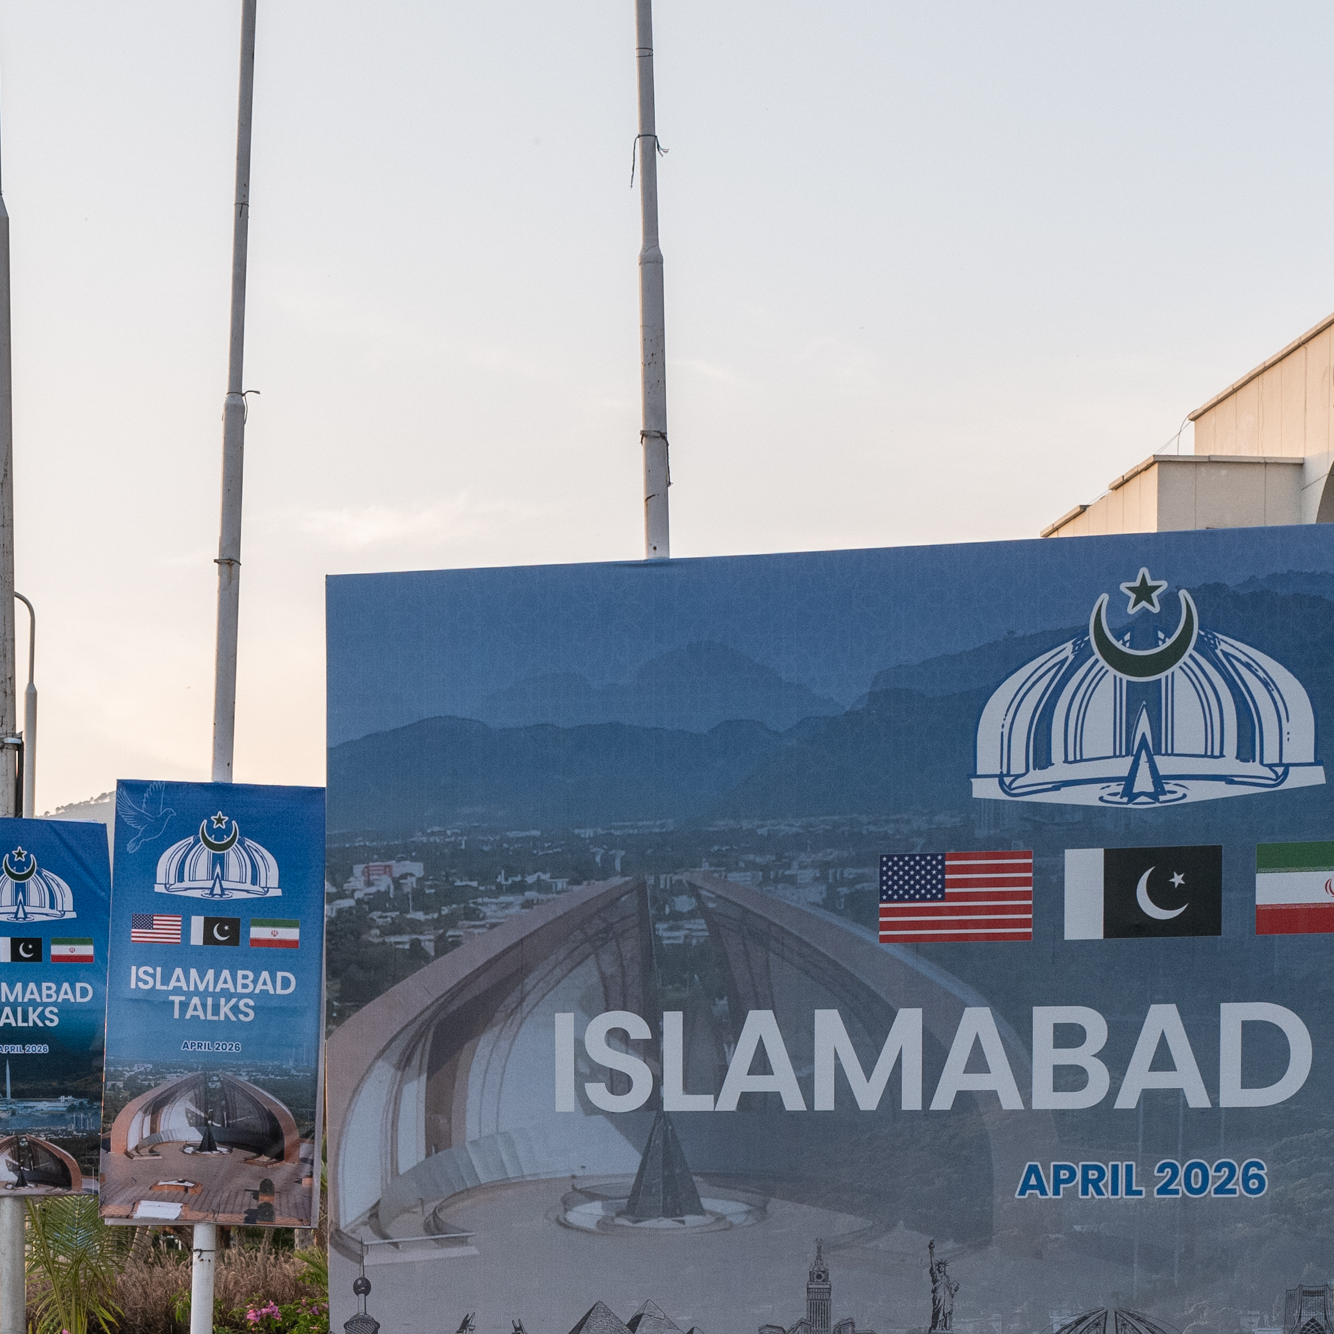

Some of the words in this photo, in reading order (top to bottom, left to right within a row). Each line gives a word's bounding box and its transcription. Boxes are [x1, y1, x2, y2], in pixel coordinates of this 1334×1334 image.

[131, 965, 297, 995] ISLAMABAD
[168, 995, 255, 1022] TALKS
[24, 1044, 50, 1054] 2026
[181, 1040, 213, 1051] APRIL
[214, 1041, 242, 1052] 2026
[554, 1001, 1313, 1112] ISLAMABAD
[1015, 1162, 1146, 1199] APRIL
[1153, 1159, 1269, 1199] 2026
